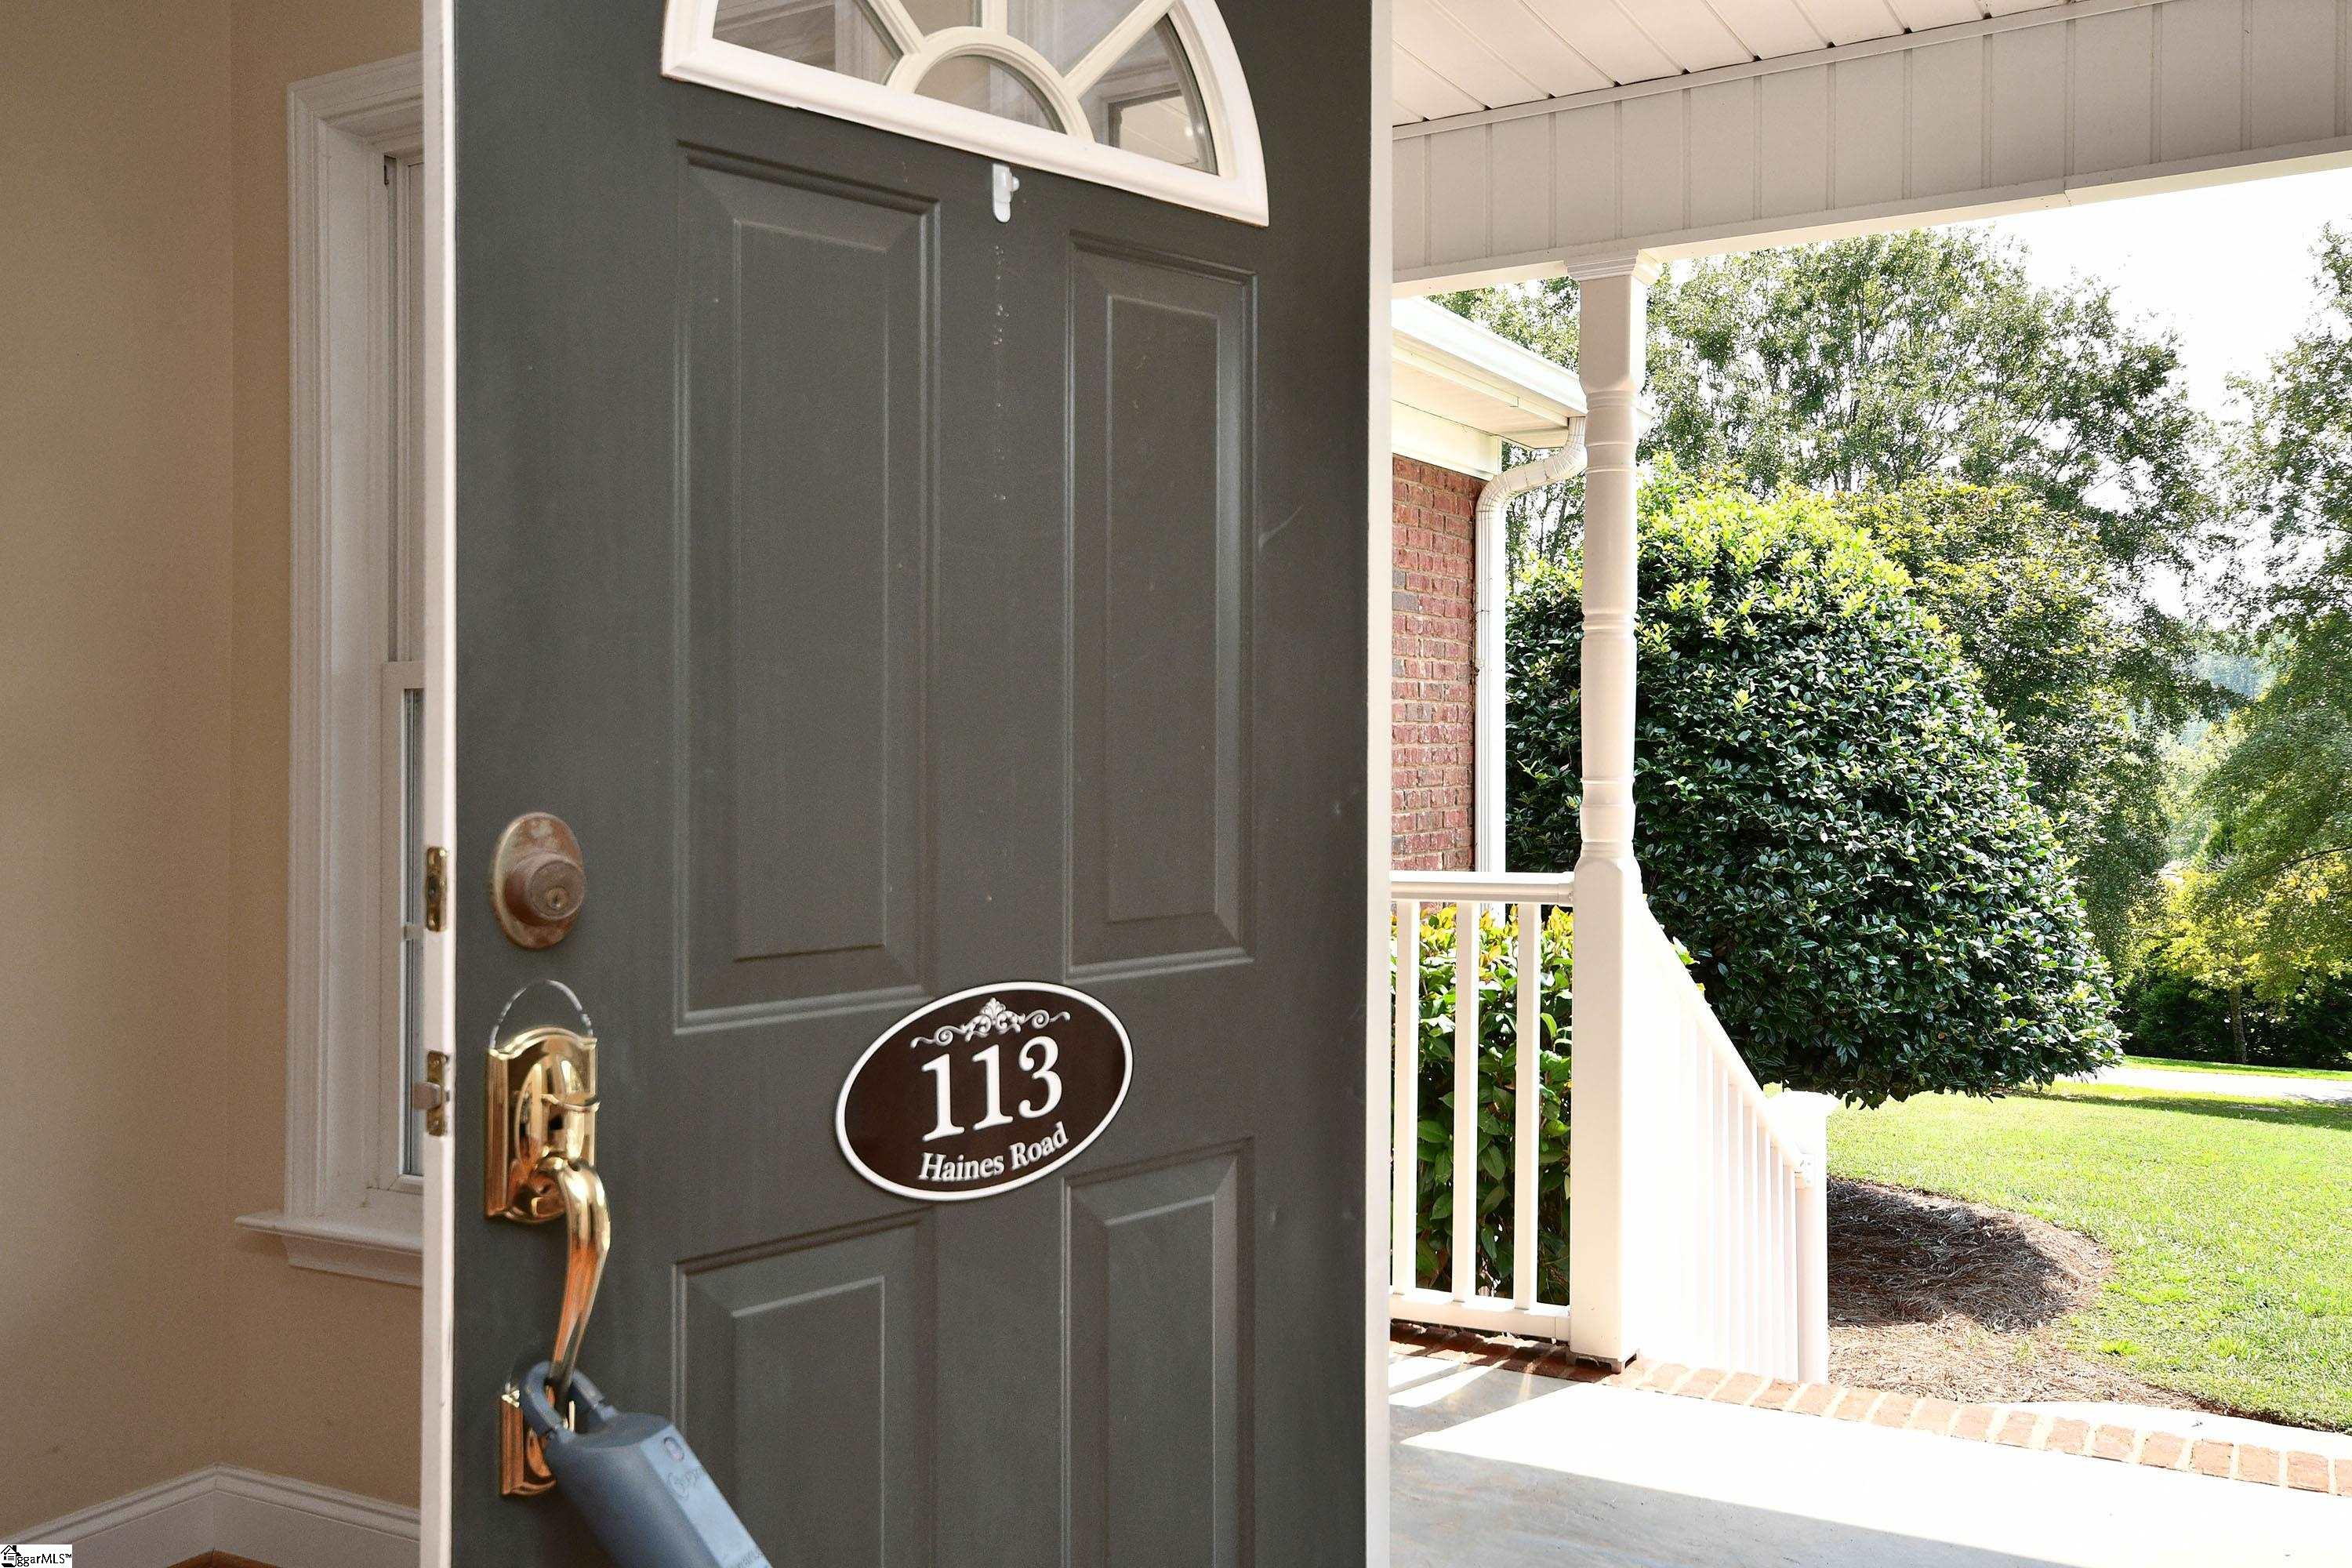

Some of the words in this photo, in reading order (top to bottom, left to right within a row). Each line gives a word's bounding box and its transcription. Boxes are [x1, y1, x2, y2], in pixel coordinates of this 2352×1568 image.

[921, 1036, 1063, 1142] 113
[917, 1152, 1006, 1182] Haines
[1009, 1121, 1070, 1171] Road
